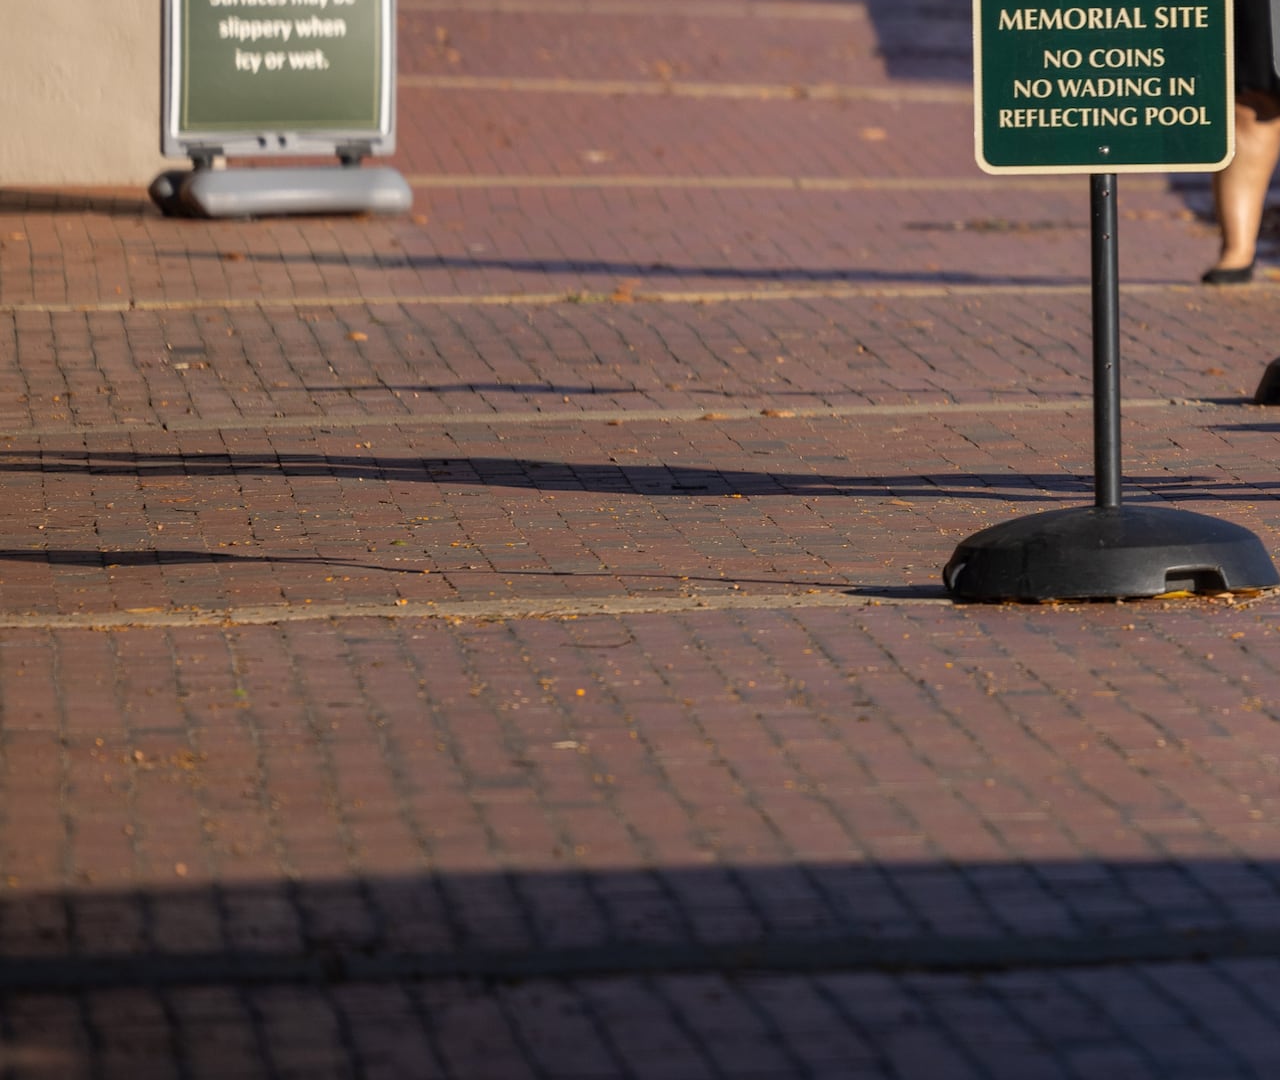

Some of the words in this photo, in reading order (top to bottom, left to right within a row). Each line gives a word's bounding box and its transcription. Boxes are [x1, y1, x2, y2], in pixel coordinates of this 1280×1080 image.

[218, 15, 293, 43] slippery
[294, 14, 348, 39] when
[999, 7, 1147, 30] MEMORIAL
[1154, 6, 1209, 29] SITE
[264, 51, 286, 71] or
[287, 48, 331, 71] wet.
[1043, 48, 1083, 69] NO
[1088, 47, 1166, 69] COINS
[1013, 78, 1053, 99] NO
[1057, 77, 1162, 99] WADING
[1169, 77, 1196, 97] IN
[999, 107, 1138, 128] REFLECTING
[1145, 106, 1212, 126] POOL
